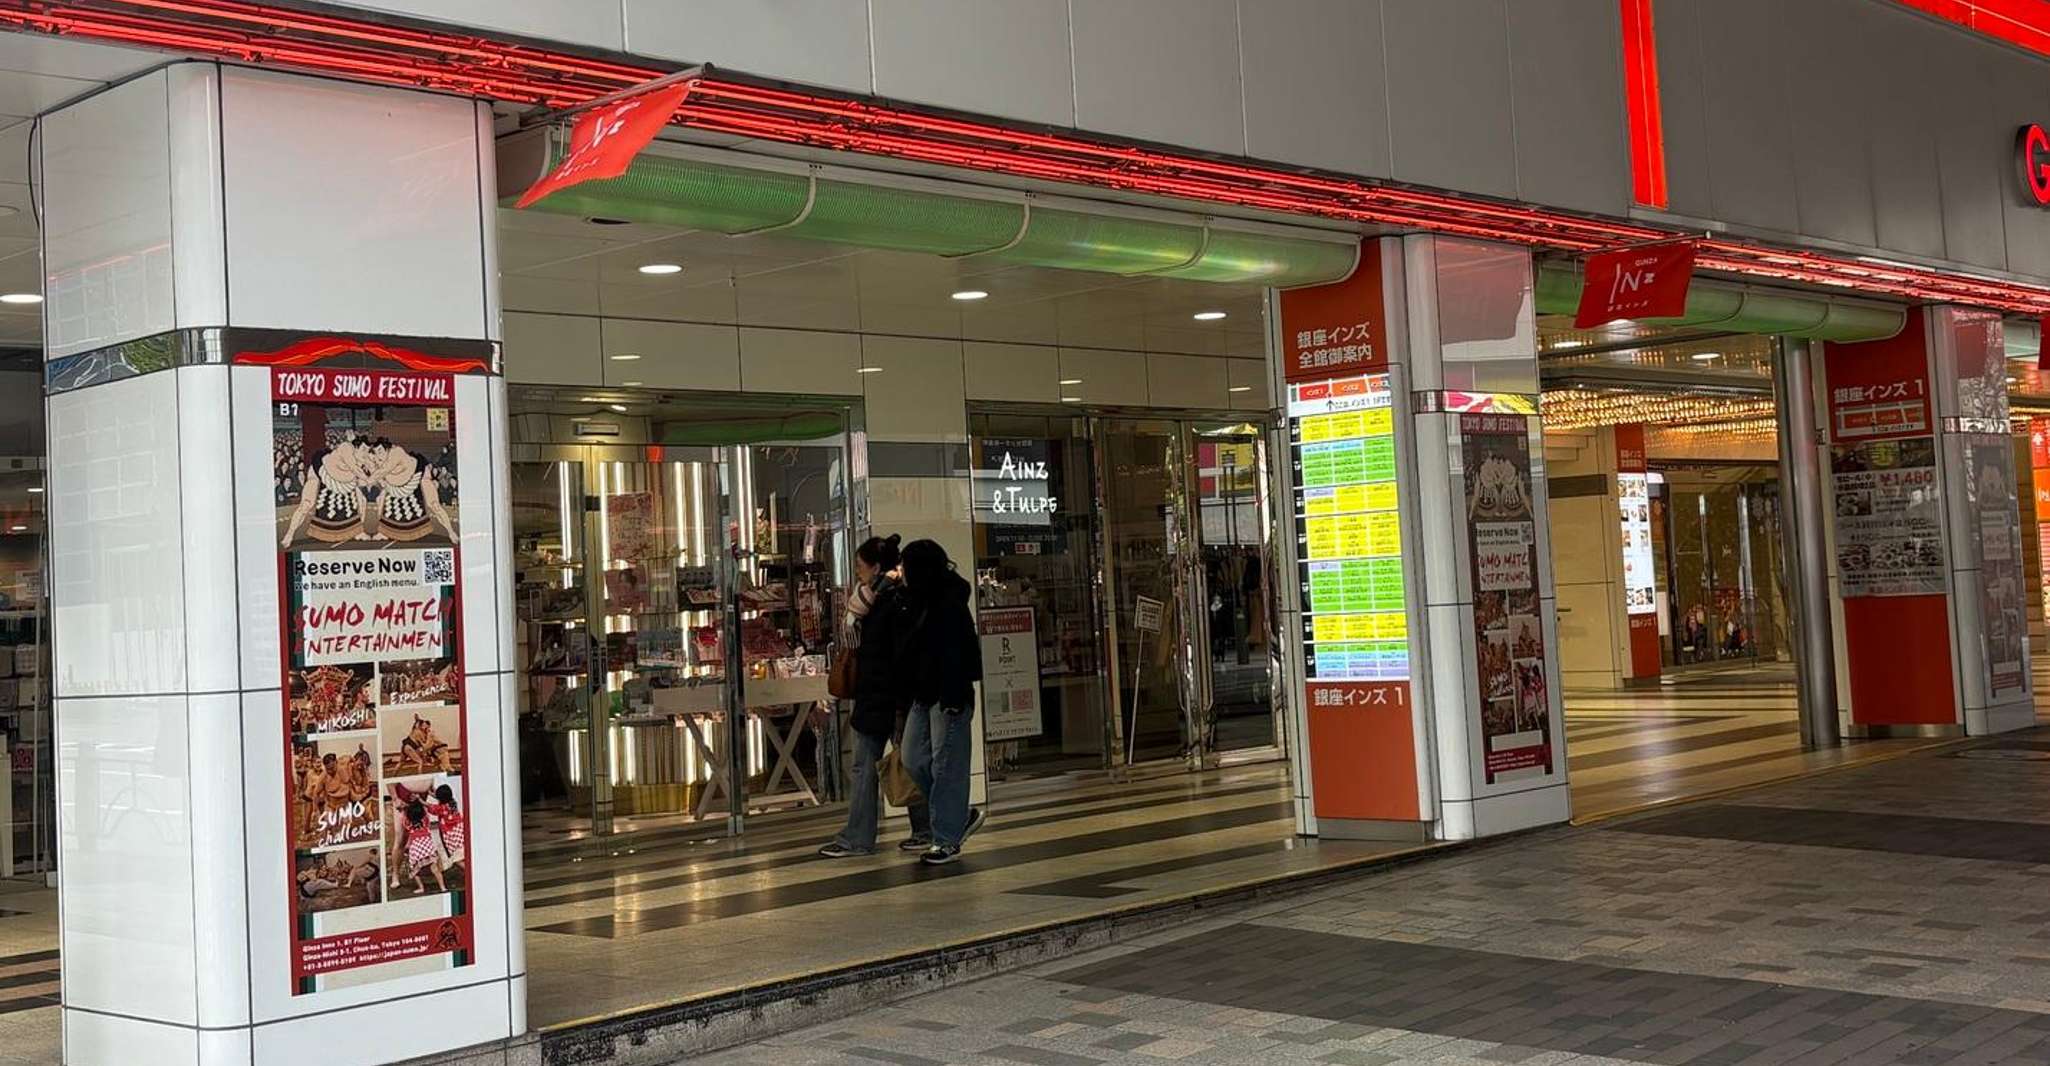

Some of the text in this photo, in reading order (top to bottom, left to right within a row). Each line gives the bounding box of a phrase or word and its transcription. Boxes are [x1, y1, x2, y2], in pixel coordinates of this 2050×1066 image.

[1297, 322, 1370, 349] 銀座インズ
[1299, 343, 1373, 368] 全館御案内
[278, 373, 450, 399] TOKYO SUMO FESTIVAL
[1834, 379, 1924, 404] 銀座インズ 1
[280, 404, 298, 416] B1
[295, 557, 416, 577] Reserve Now
[1504, 551, 1528, 568] MATC
[311, 581, 336, 590] have
[339, 581, 350, 589] an
[354, 579, 389, 590] English
[391, 579, 420, 588] menu.
[294, 596, 454, 632] SUMO MATCH
[390, 682, 449, 704] Experience
[1313, 686, 1404, 706] 銀座インズ 1
[317, 709, 369, 731] MIKOSHI
[316, 800, 365, 832] SUMO
[318, 820, 385, 848] challenge
